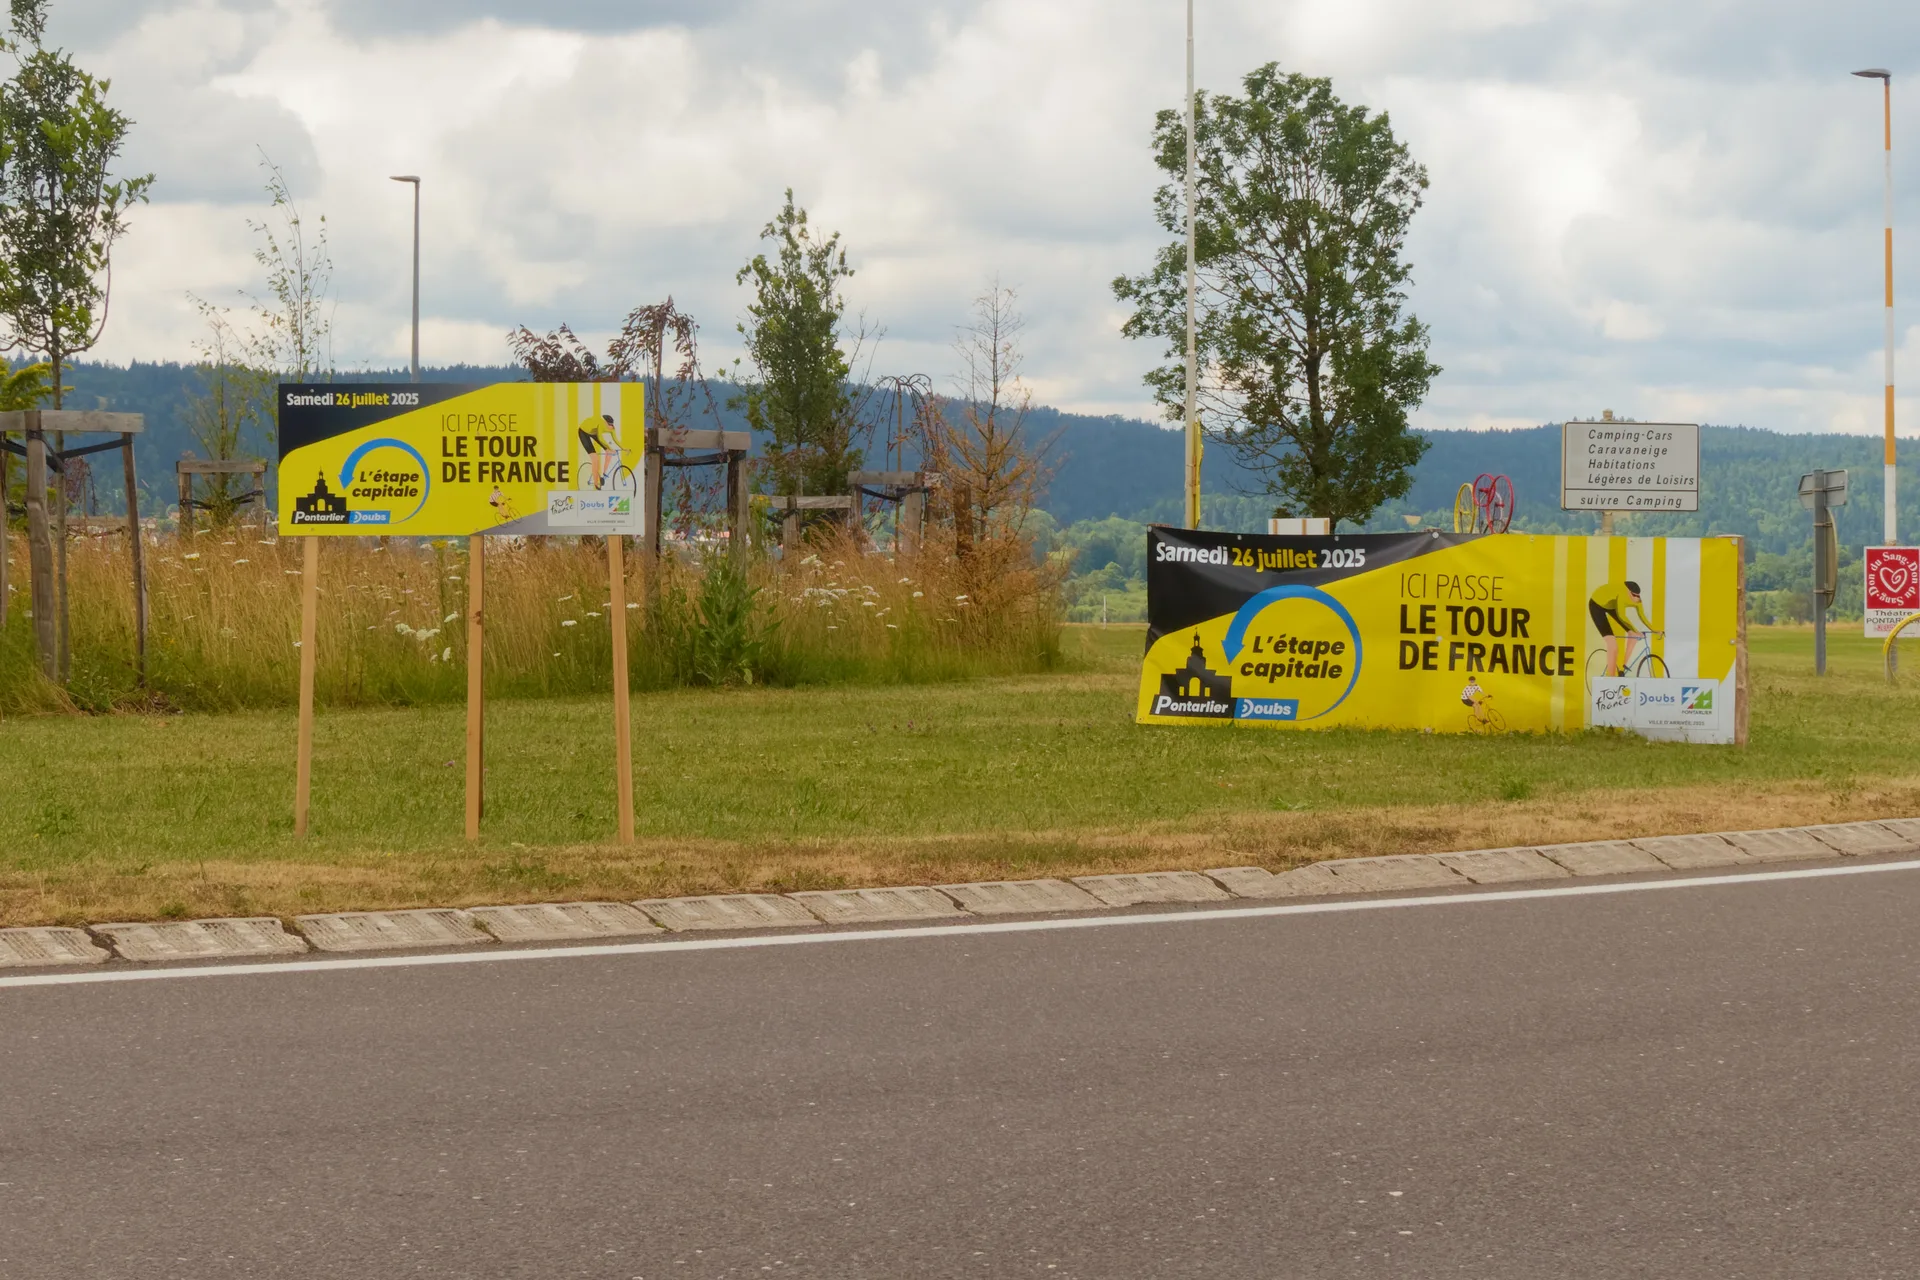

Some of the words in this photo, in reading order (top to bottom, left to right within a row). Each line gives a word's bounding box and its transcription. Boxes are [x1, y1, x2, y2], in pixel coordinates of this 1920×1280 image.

[286, 393, 334, 406] Samedi
[335, 393, 350, 406] 26
[351, 393, 390, 409] juillet
[391, 393, 419, 406] 2025
[441, 413, 461, 432] ICI
[467, 413, 518, 432] PASSE
[441, 435, 468, 458] LE
[475, 435, 538, 458] TOUR
[1588, 444, 1668, 458] Caravaneige
[441, 461, 471, 483] DE
[478, 461, 570, 483] FRANCE
[1588, 459, 1656, 470] Habitations
[1588, 473, 1633, 486] Légères
[1637, 475, 1652, 485] de
[1656, 475, 1695, 486] Loisirs
[352, 484, 419, 501] capitale
[1580, 495, 1620, 505] suivre
[1626, 495, 1683, 508] Camping
[294, 511, 345, 524] Pontarlier
[353, 511, 387, 524] Doubs
[1156, 542, 1228, 565] Samedi
[1231, 548, 1255, 567] 26
[1256, 548, 1318, 573] juillet
[1321, 549, 1366, 569] 2025
[1870, 559, 1882, 571] du
[1882, 551, 1908, 566] Sang
[1907, 561, 1918, 584] Don
[1400, 573, 1427, 598] ICI
[1436, 574, 1504, 601] PASSE
[1869, 573, 1880, 597] Don
[1904, 586, 1916, 599] du
[1879, 592, 1904, 606] Sang
[1400, 604, 1437, 635] LE
[1446, 605, 1530, 639] TOUR
[1399, 640, 1439, 671] DE
[1448, 641, 1575, 677] FRANCE
[1240, 657, 1343, 683] capitale
[1154, 695, 1229, 715] Pontarlier
[1240, 698, 1292, 718] Doubs
[1639, 692, 1675, 706] Doubs
